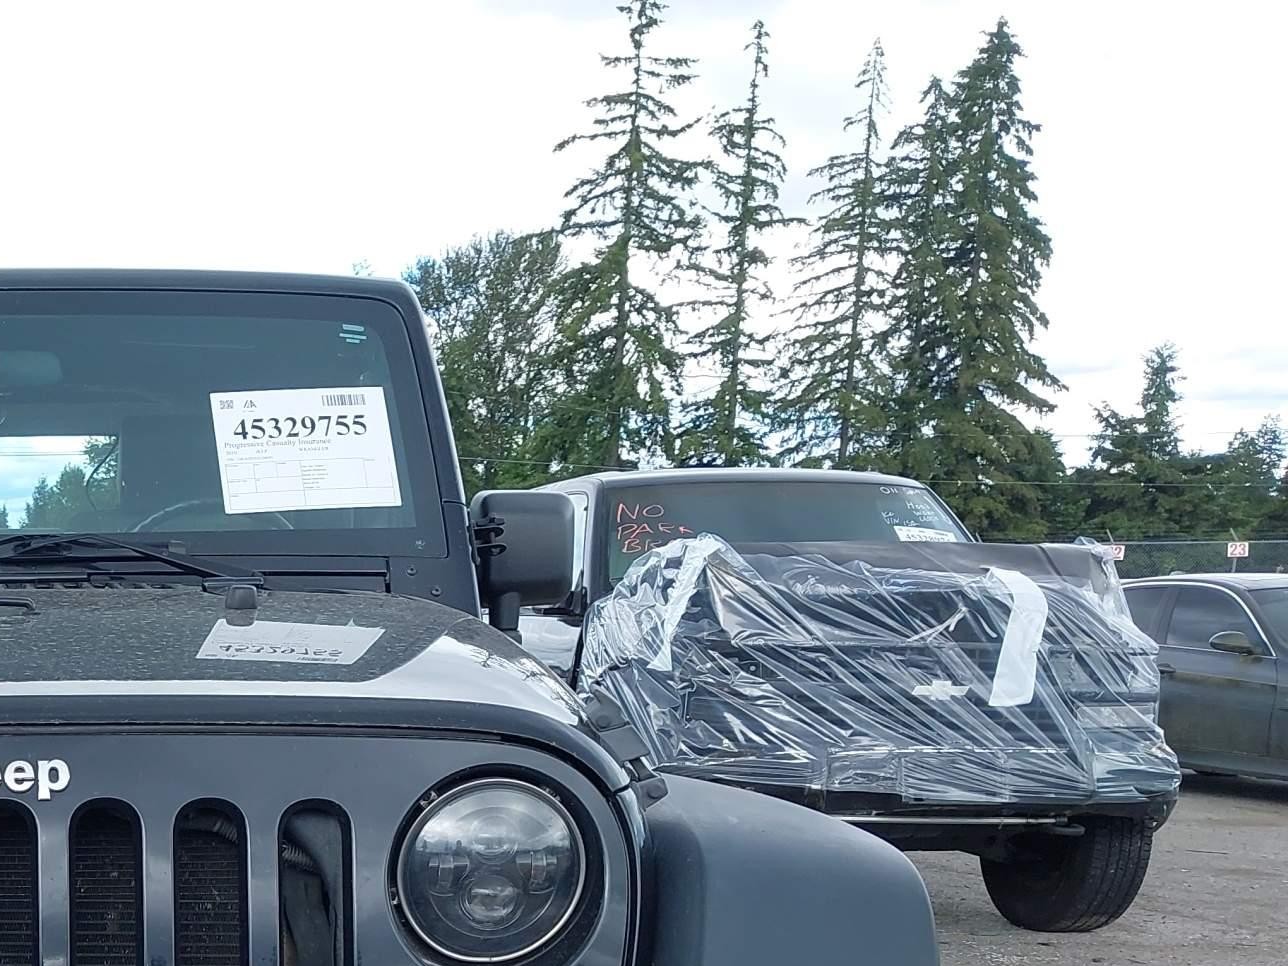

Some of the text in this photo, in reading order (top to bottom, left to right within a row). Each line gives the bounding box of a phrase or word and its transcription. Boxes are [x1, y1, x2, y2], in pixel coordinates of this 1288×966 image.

[233, 414, 367, 440] 45329755
[266, 438, 297, 447] Casualty
[298, 437, 331, 446] Insurance
[616, 503, 664, 523] NO
[1229, 543, 1246, 556] 23
